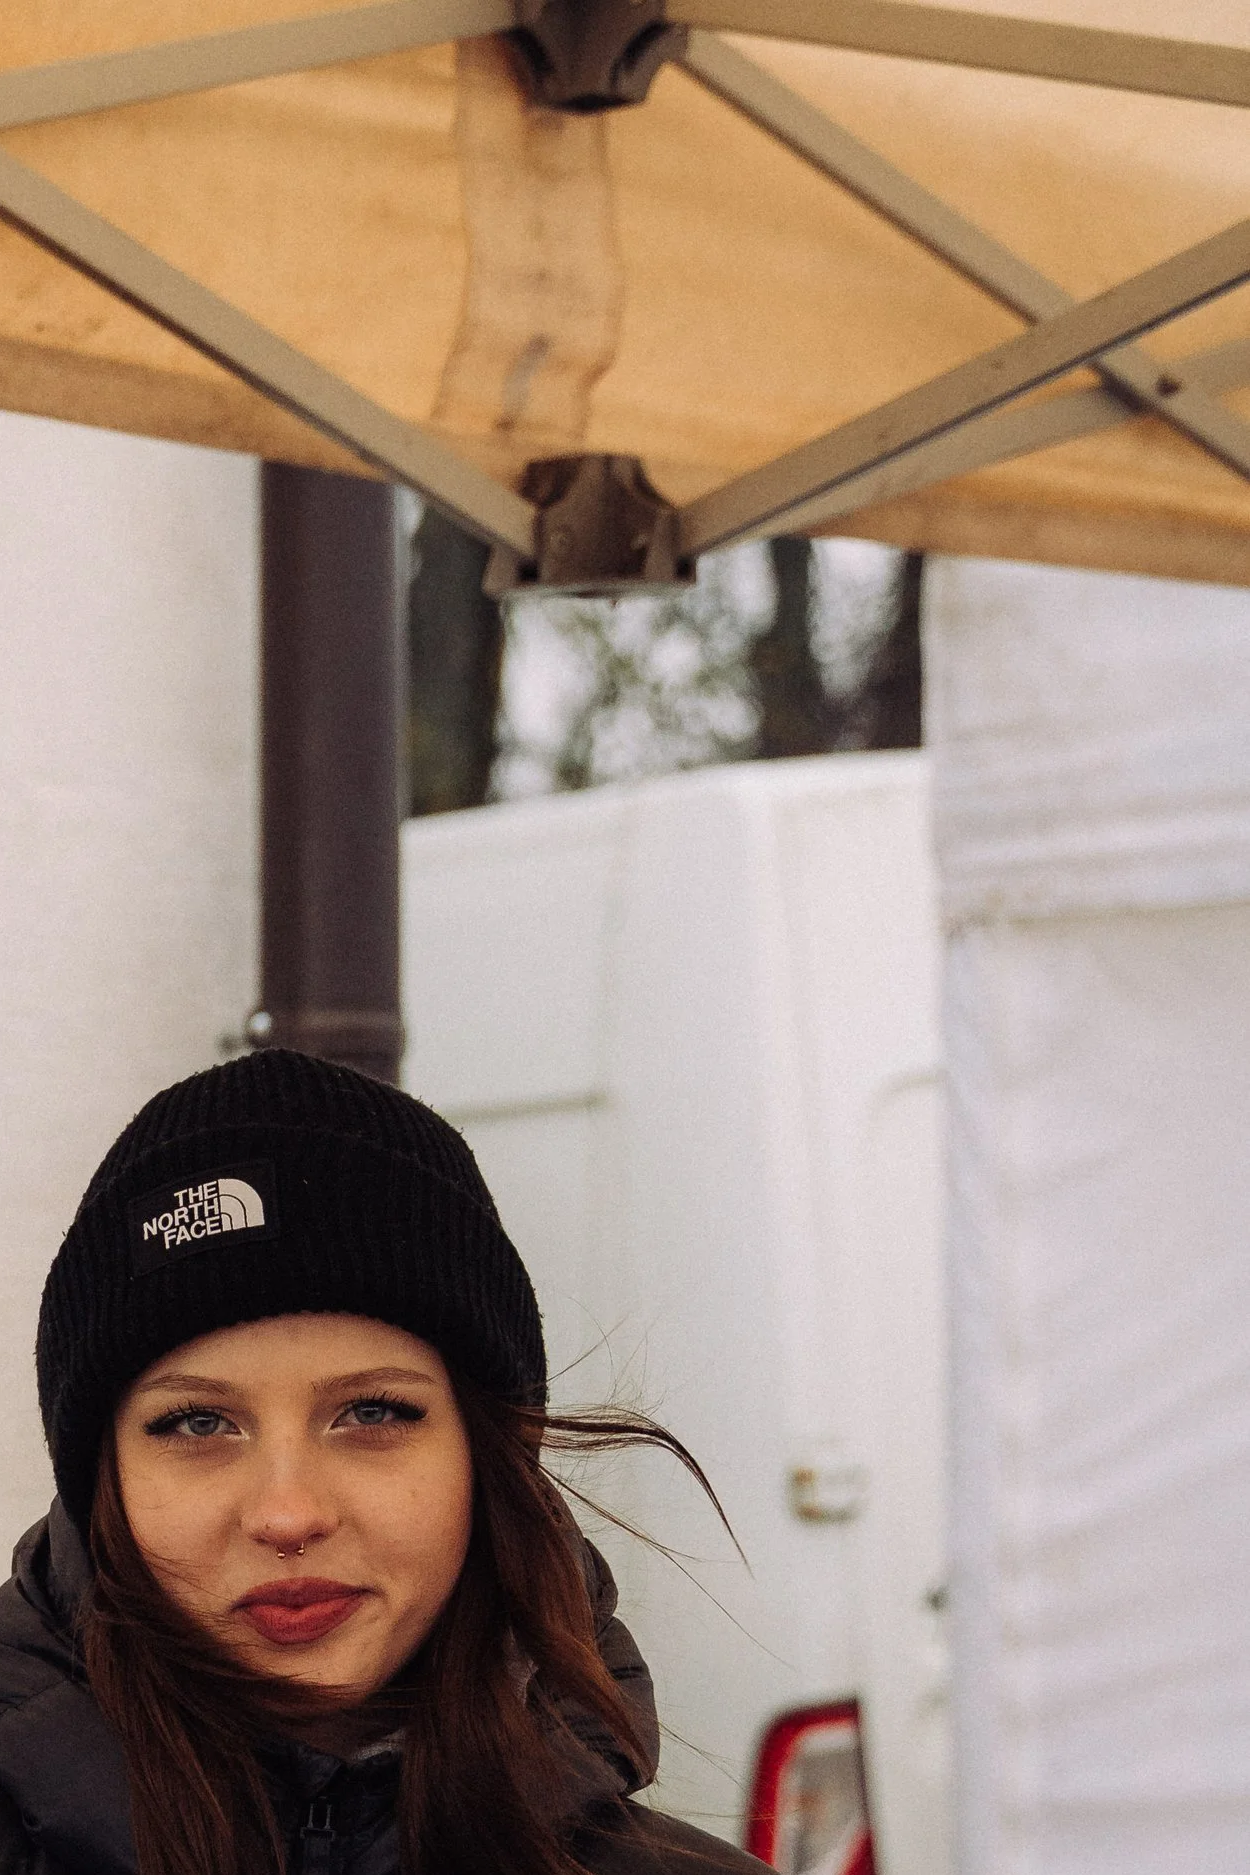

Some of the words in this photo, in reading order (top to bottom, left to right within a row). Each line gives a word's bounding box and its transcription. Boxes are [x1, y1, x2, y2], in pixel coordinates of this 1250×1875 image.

[174, 1180, 219, 1207] THE
[143, 1197, 220, 1240] NORTH
[163, 1215, 222, 1249] FACE
